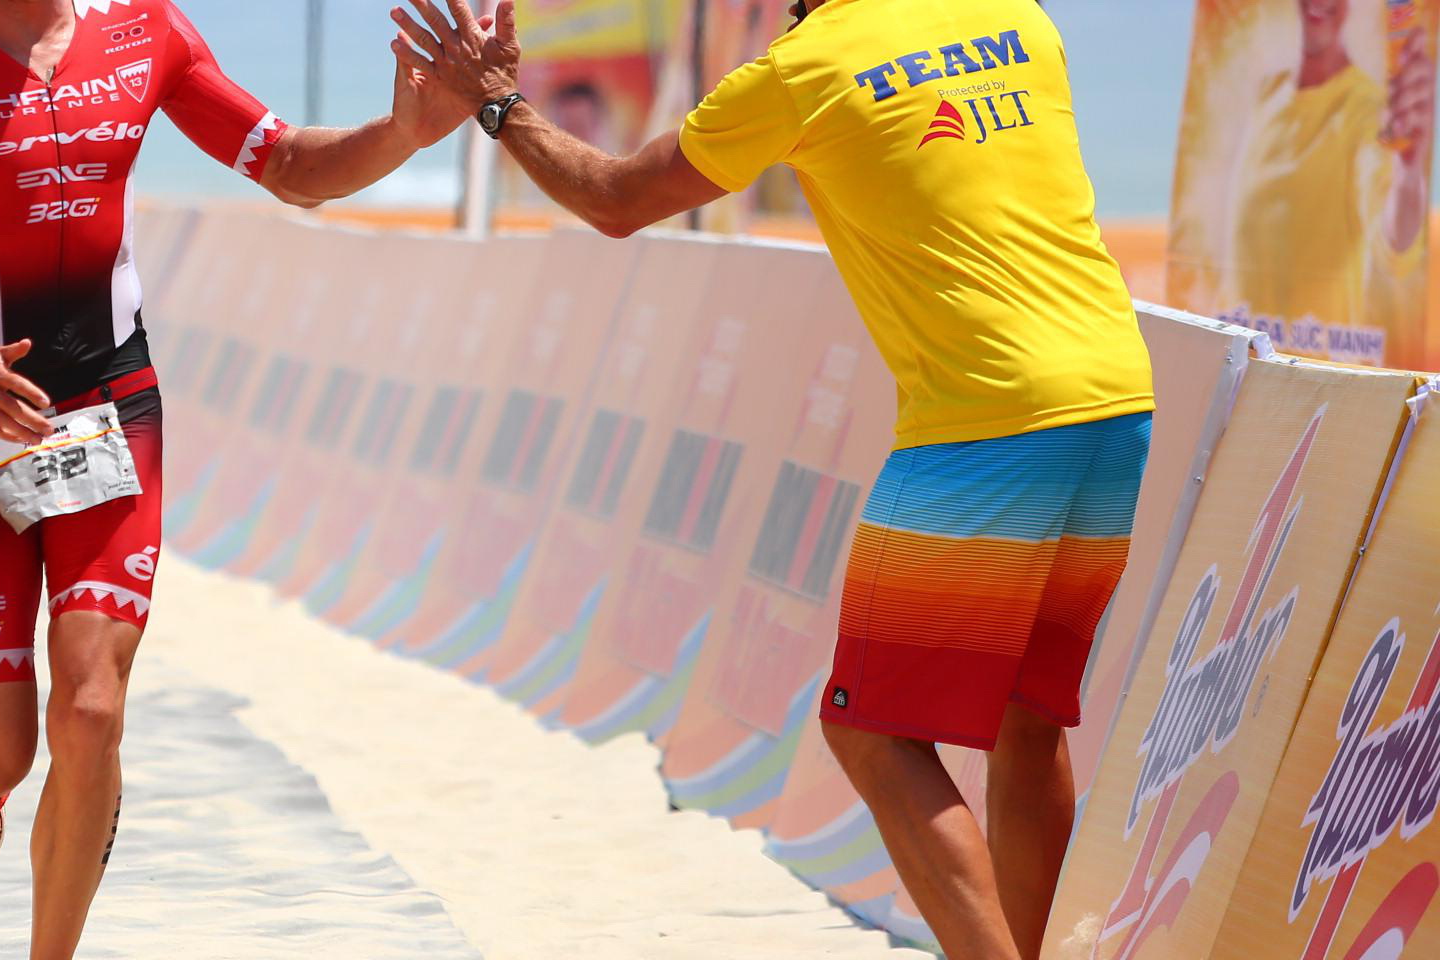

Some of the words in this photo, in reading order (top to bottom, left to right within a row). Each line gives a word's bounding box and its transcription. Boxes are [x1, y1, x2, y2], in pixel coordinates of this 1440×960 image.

[104, 36, 152, 55] ROTOR
[853, 29, 1030, 103] TEAM
[129, 76, 143, 87] 13
[937, 82, 991, 100] Protected
[992, 78, 1006, 92] by
[962, 89, 1034, 144] JLT
[26, 196, 101, 225] 32Gi
[32, 445, 89, 488] 32
